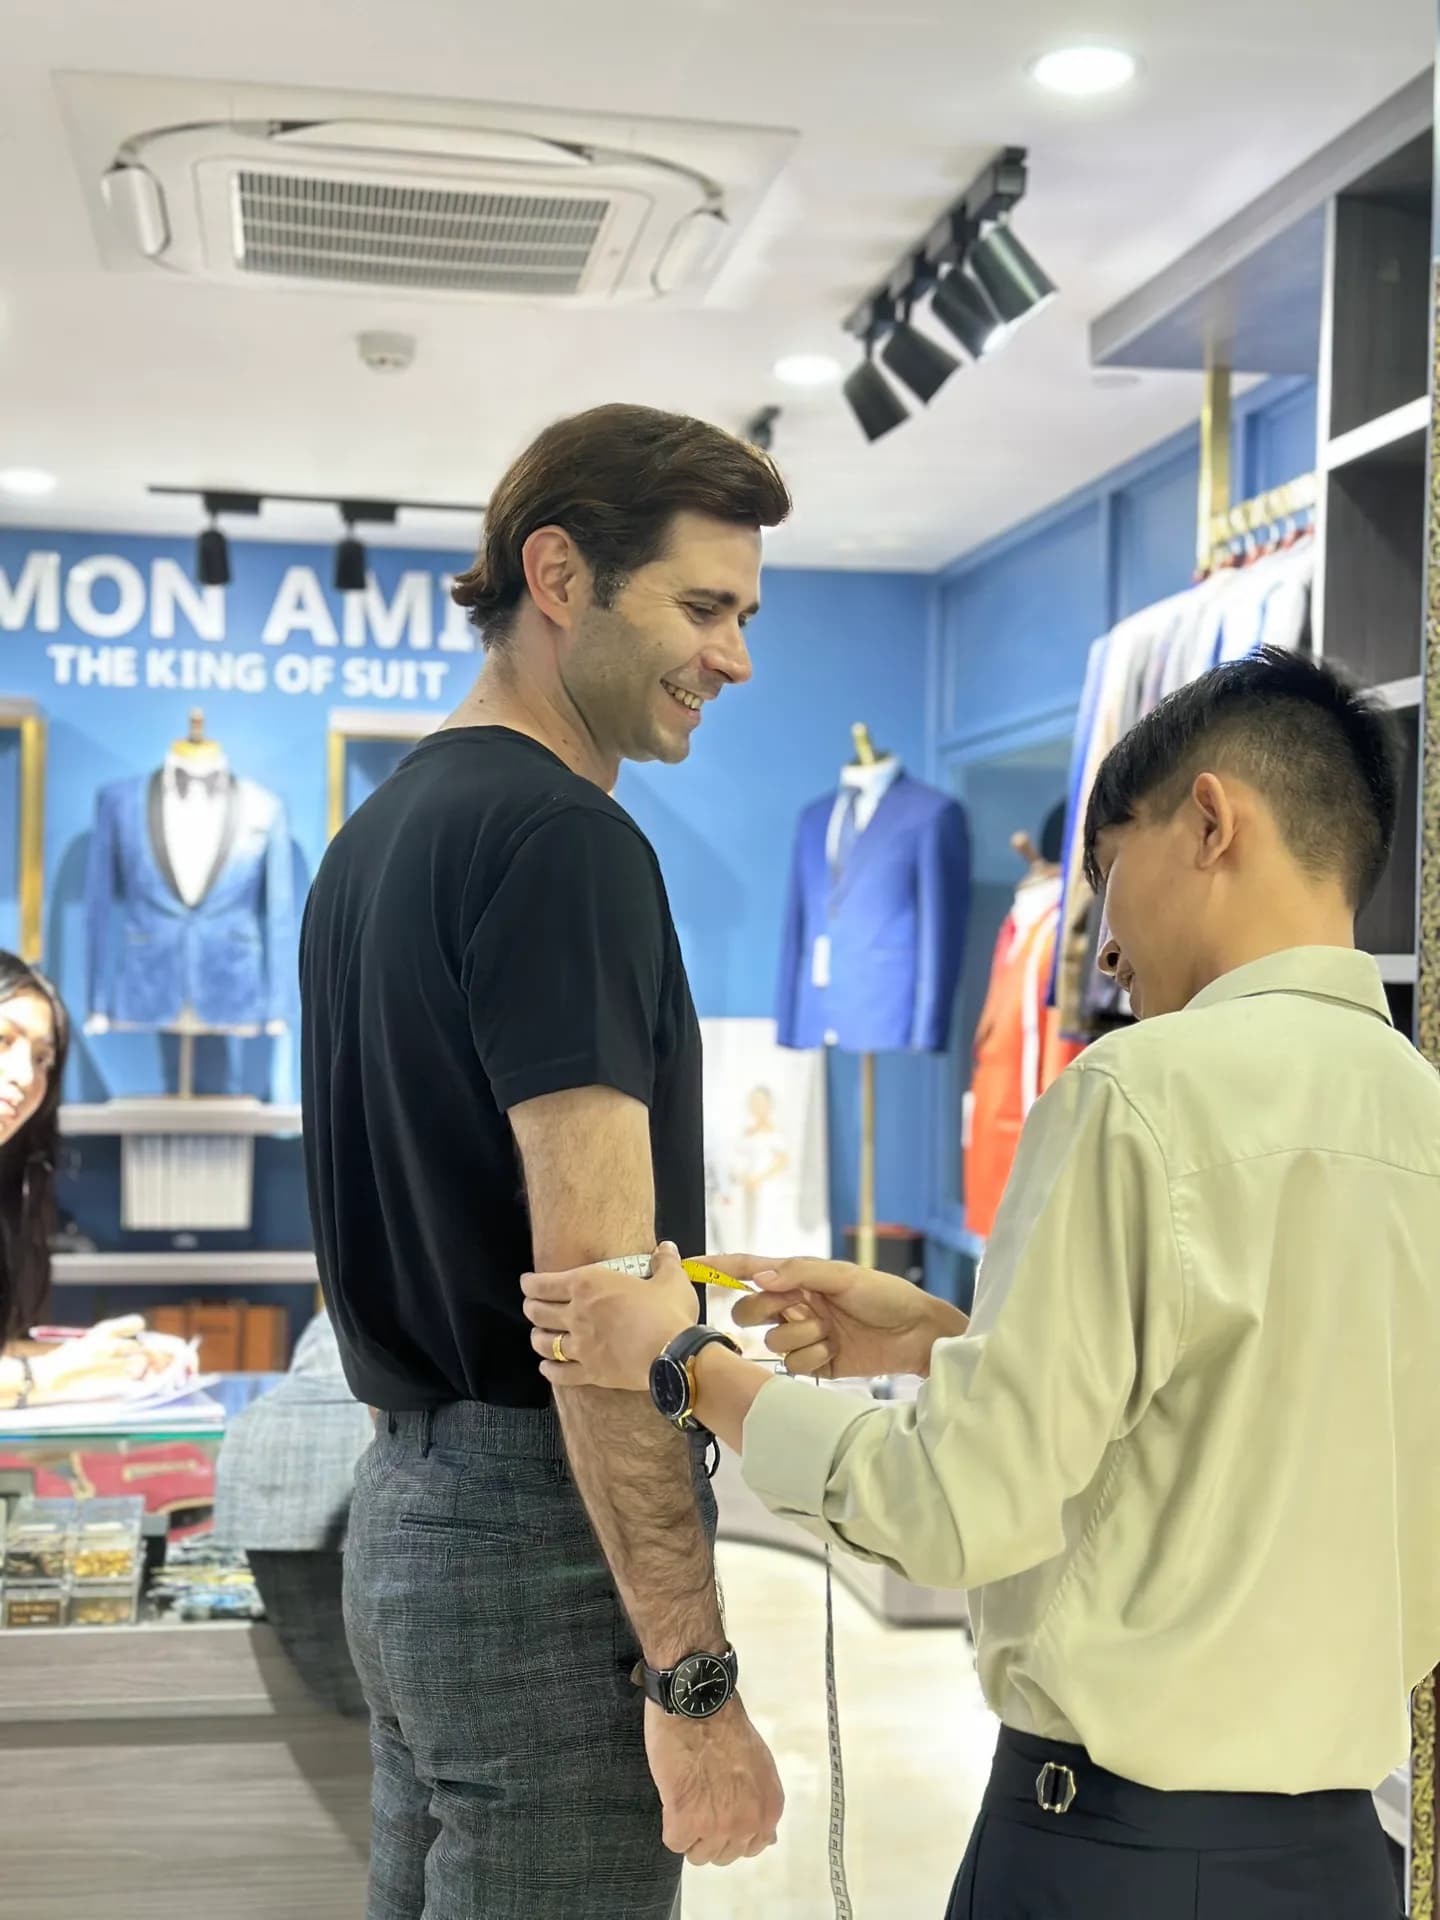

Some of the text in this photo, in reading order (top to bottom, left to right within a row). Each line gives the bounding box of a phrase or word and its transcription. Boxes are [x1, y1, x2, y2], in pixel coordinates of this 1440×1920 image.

[0, 550, 474, 651] MON AMI
[47, 644, 449, 700] THE KING OF SUIT
